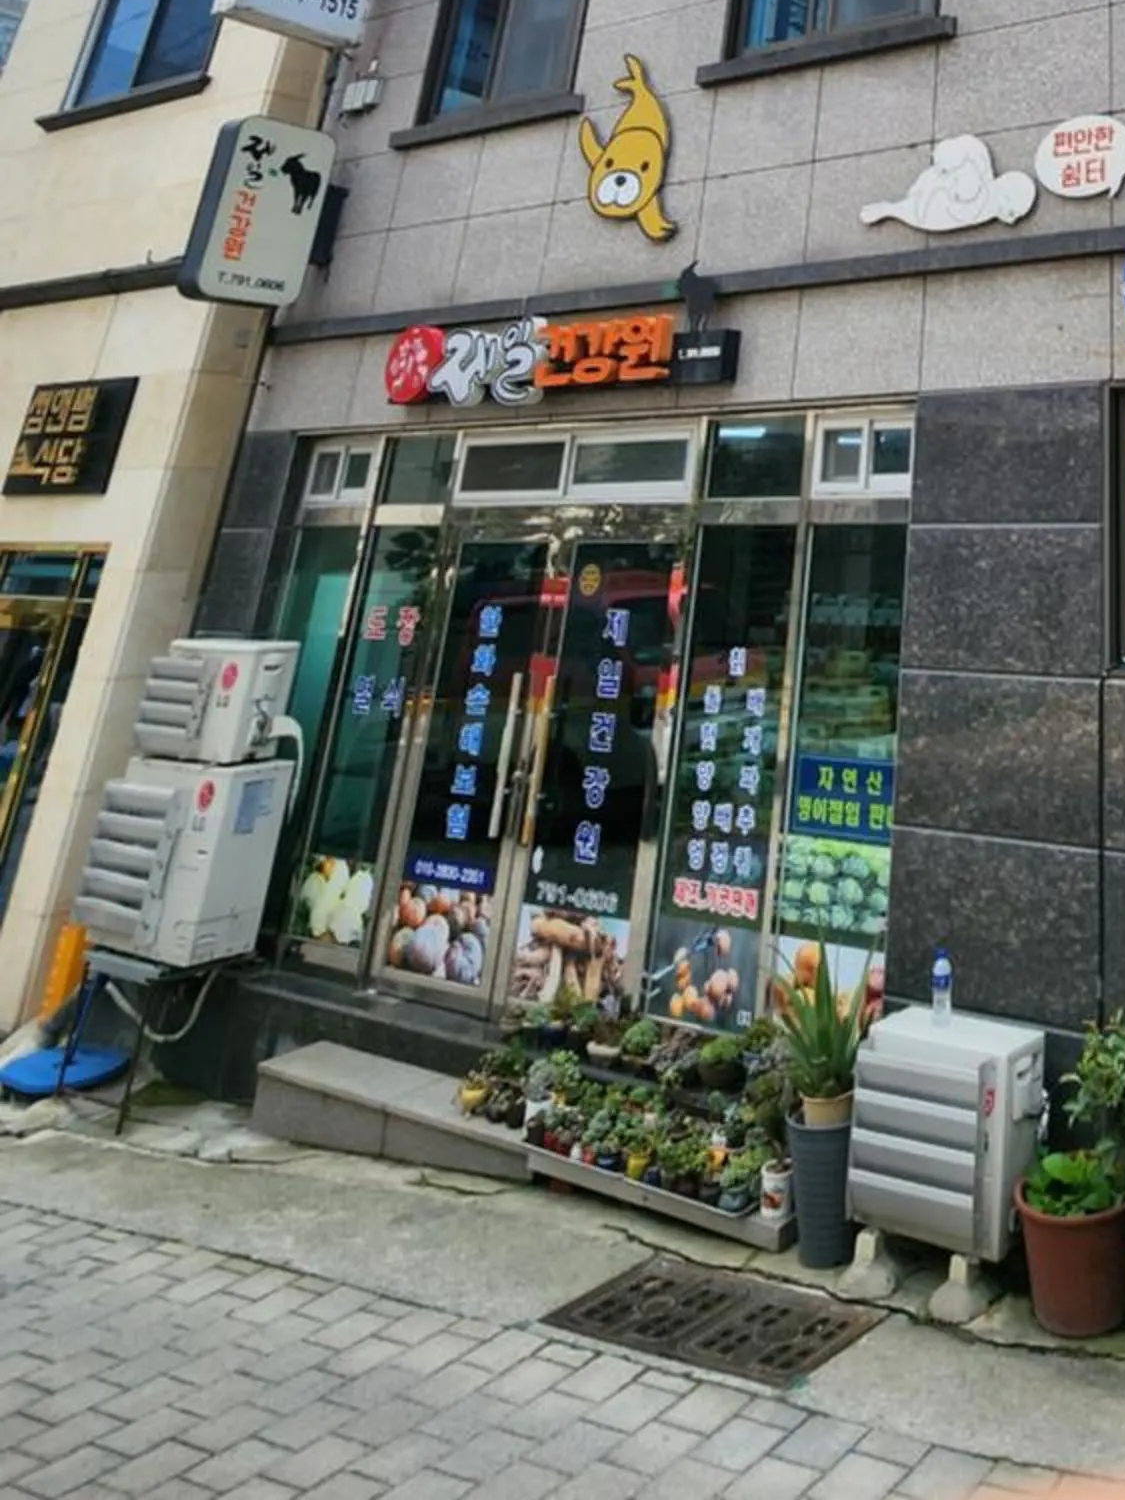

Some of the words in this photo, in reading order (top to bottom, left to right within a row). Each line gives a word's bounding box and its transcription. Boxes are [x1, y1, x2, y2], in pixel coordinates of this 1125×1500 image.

[1053, 125, 1115, 157] 편안한
[1061, 159, 1106, 188] 쉼터
[534, 313, 674, 388] 건강원
